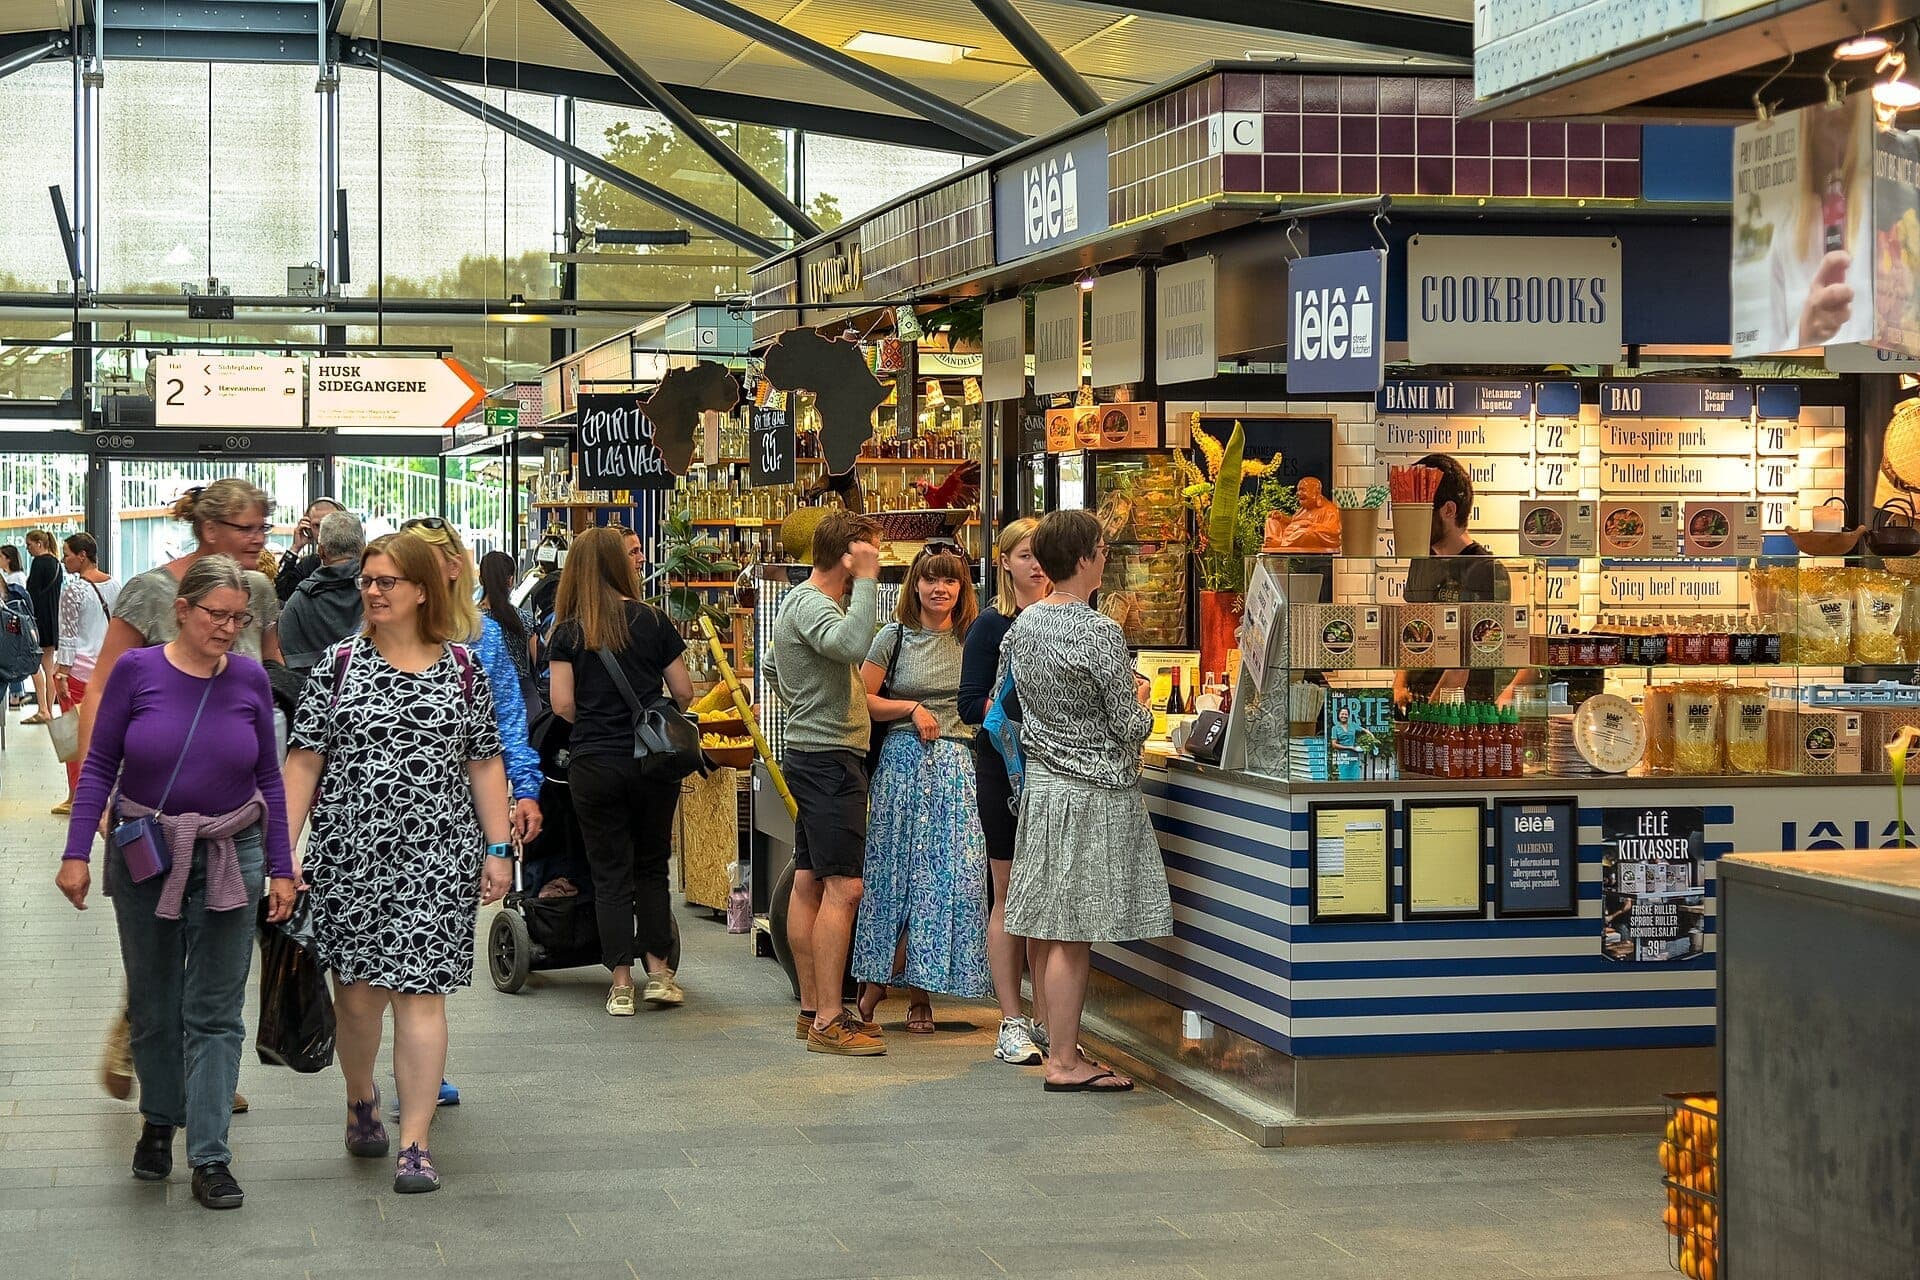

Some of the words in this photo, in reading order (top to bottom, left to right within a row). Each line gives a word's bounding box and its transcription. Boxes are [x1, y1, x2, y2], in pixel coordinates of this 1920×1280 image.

[1479, 5, 1487, 38] 7
[1211, 121, 1218, 148] 6
[1233, 119, 1255, 146] C
[1740, 140, 1752, 164] PAY
[1754, 136, 1772, 161] YOUR
[1738, 168, 1751, 194] NOT
[1753, 164, 1771, 190] YOUR
[1023, 158, 1061, 246] lêlê
[1421, 275, 1607, 325] COOKBOOKS
[1294, 287, 1349, 361] lêlê
[701, 329, 715, 346] C
[318, 366, 361, 377] HUSK
[166, 378, 185, 406] 2
[318, 381, 427, 393] SIDEGANGENE
[1386, 381, 1429, 410] BÁNH
[1435, 382, 1456, 410] MÌ
[1481, 387, 1522, 399] Vietnamese
[1611, 387, 1641, 411] BAO
[1704, 389, 1734, 401] Steamed
[520, 401, 529, 411] C
[1481, 400, 1513, 412] baguette
[1704, 401, 1725, 412] bread
[582, 407, 653, 447] SPIRITU
[1388, 424, 1452, 449] Five-spice
[1457, 424, 1486, 449] pork
[1611, 425, 1674, 451] Five-spice
[1678, 426, 1707, 451] pork
[1611, 465, 1650, 483] Pulled
[1654, 464, 1703, 483] chicken
[1611, 576, 1644, 601] Spicy
[1650, 576, 1677, 596] beef
[1681, 579, 1722, 601] ragout
[1332, 697, 1390, 726] URTE
[1514, 816, 1543, 833] lêlê
[1638, 810, 1669, 837] LÊLÊ
[1516, 843, 1554, 854] ALLERGENER
[1618, 838, 1689, 860] KITKASSER
[1520, 857, 1550, 867] information
[1551, 858, 1560, 867] om
[1510, 879, 1531, 890] venligst
[1630, 916, 1653, 927] SPRØDE
[1655, 915, 1678, 926] RULLER
[1632, 904, 1653, 915] FRISKE
[1654, 904, 1677, 915] RULLER
